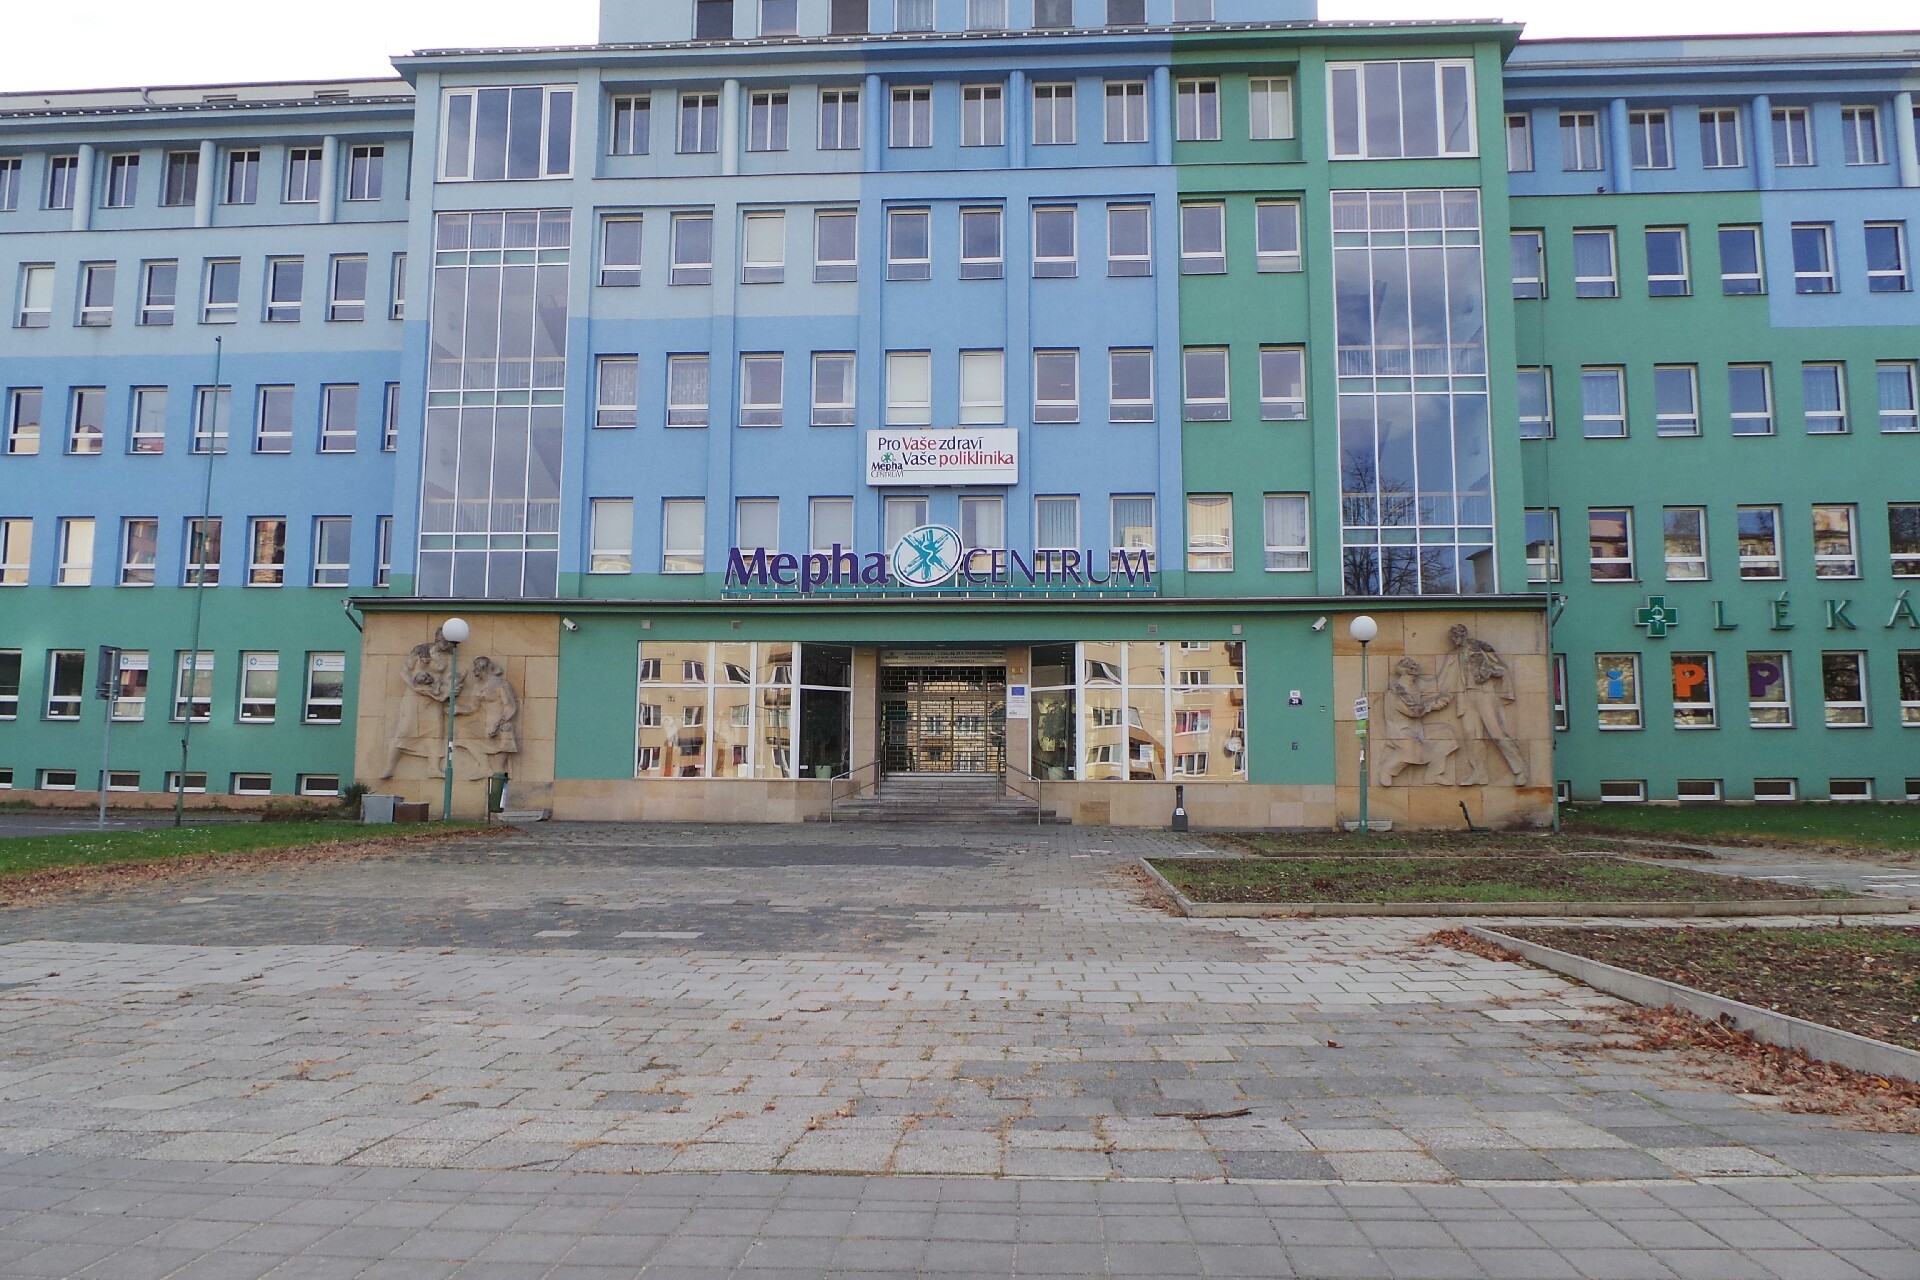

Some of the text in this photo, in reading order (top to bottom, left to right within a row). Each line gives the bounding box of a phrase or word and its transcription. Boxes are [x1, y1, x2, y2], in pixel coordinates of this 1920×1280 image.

[878, 436, 984, 450] Pro Vaše zdraví
[871, 461, 903, 471] Mepha
[902, 450, 1014, 467] Vaše poliklinika
[870, 470, 904, 478] CENTRUM
[724, 543, 1153, 593] Mepha CENTRUM
[1713, 589, 1920, 630] LÉKÁ
